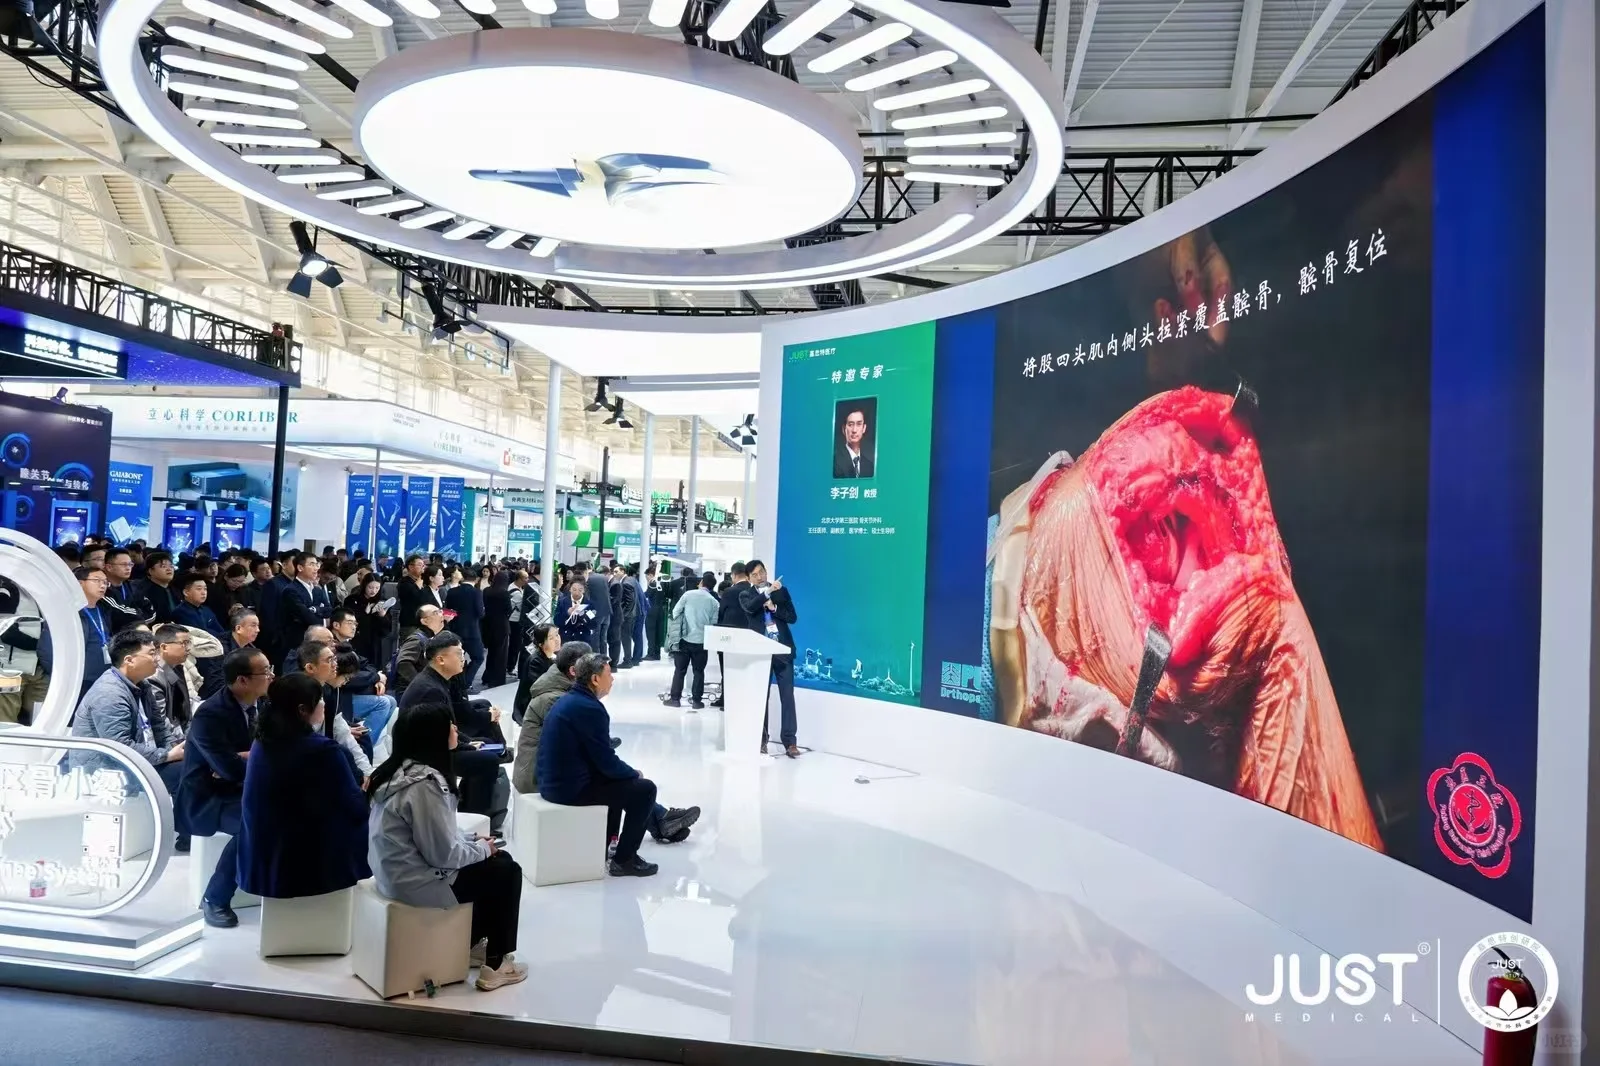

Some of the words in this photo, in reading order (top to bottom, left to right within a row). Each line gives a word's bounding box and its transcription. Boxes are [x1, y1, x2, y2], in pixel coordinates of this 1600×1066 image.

[831, 364, 884, 384] 特邀专家
[148, 408, 206, 420] 立心科学
[212, 410, 298, 423] CORLIBR
[830, 486, 859, 500] 李子剑
[863, 488, 878, 499] 教授
